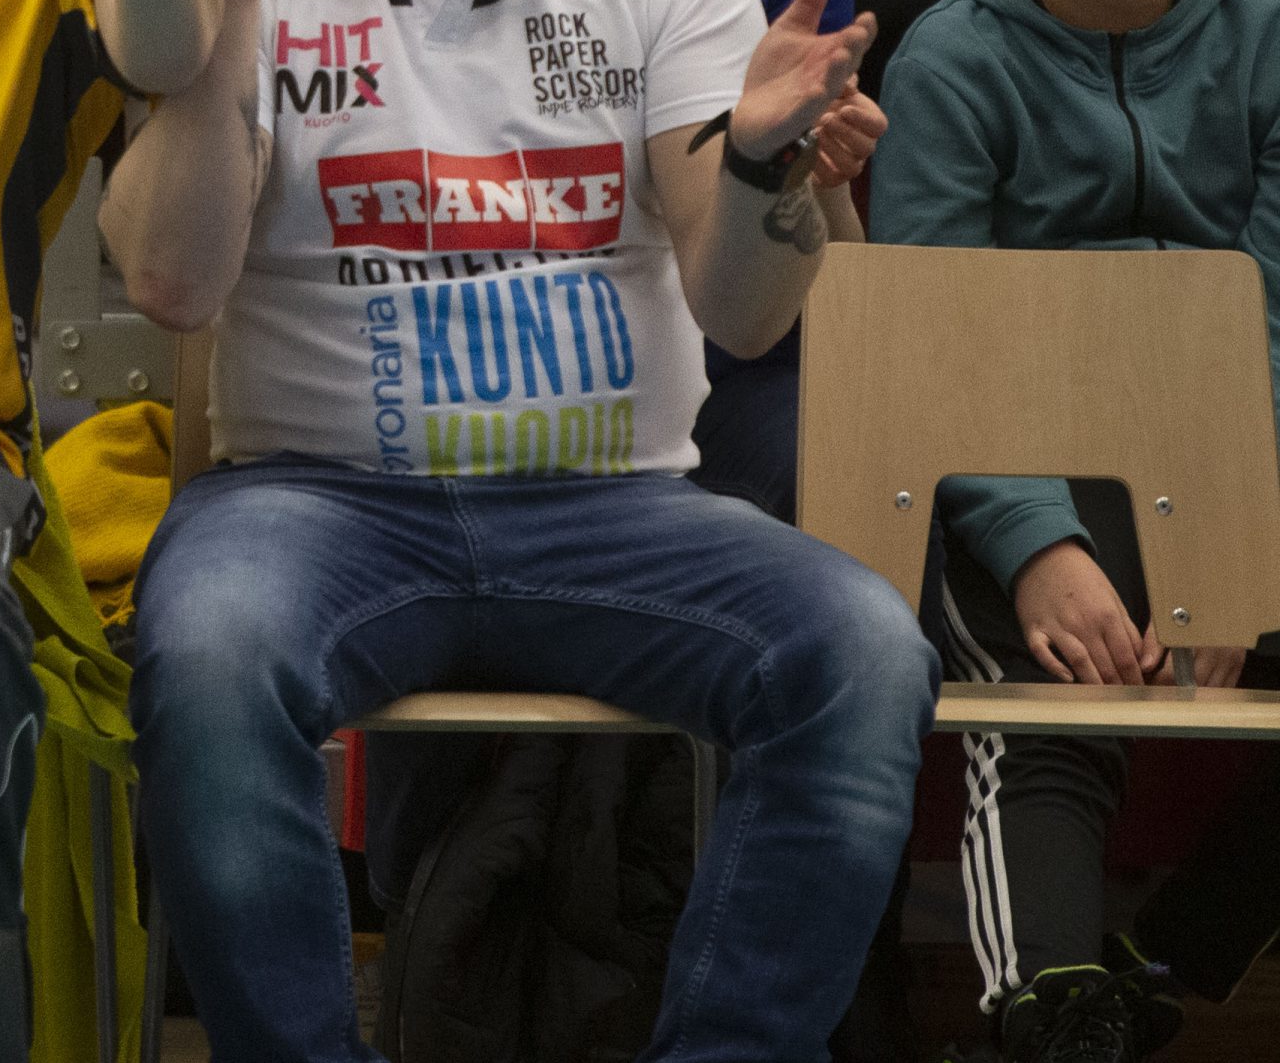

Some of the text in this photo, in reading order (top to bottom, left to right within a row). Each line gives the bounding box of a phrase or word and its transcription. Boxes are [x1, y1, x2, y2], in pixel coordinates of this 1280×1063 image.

[276, 17, 384, 67] HIT
[525, 12, 591, 44] ROCK
[529, 38, 609, 75] PAPER
[275, 62, 385, 114] MIX
[533, 66, 647, 103] SCISSORS
[327, 172, 623, 228] FRANKE
[412, 270, 636, 407] KUNTO
